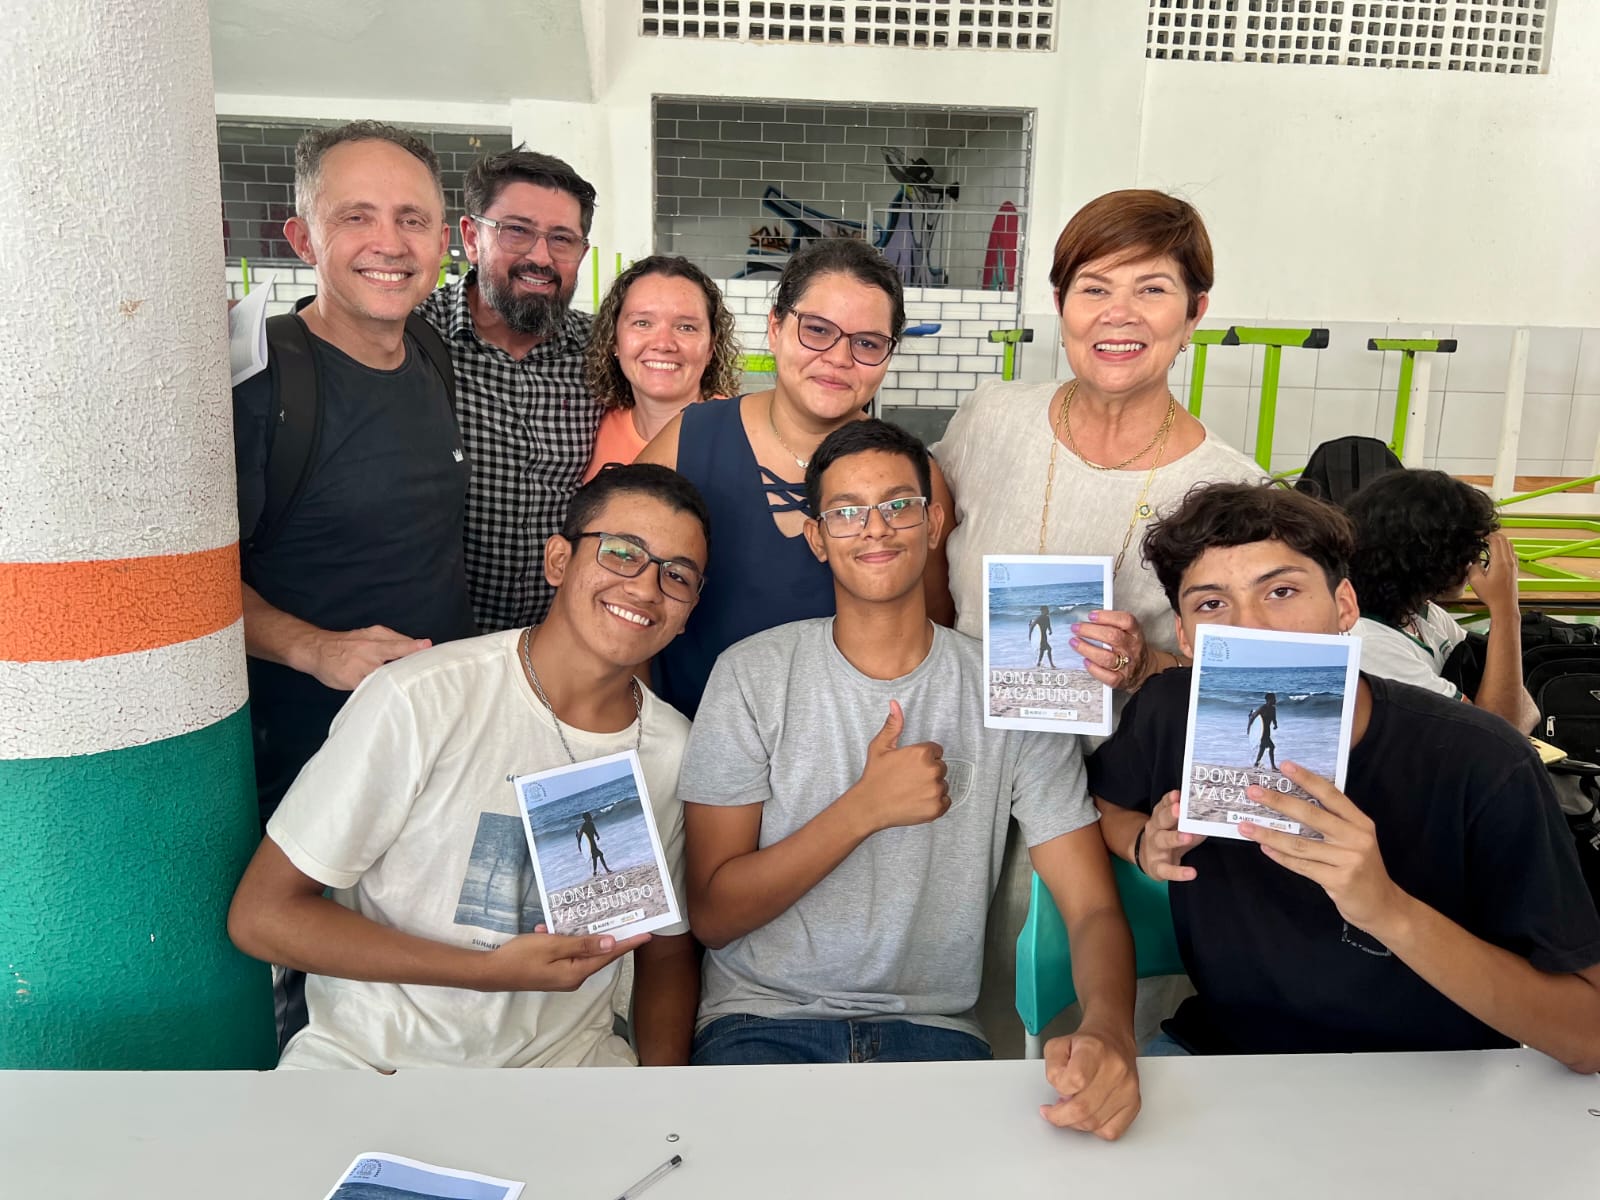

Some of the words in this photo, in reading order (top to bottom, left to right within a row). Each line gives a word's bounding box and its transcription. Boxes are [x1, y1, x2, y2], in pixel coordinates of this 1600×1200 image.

[992, 671, 1035, 685] DONA
[1041, 672, 1051, 686] E
[1056, 673, 1068, 687] O
[992, 686, 1091, 703] VAGABUNDO
[1193, 765, 1249, 787] DONA
[1258, 774, 1271, 789] E
[1276, 777, 1292, 793] O
[551, 884, 596, 908] DONA
[600, 879, 611, 894] E
[614, 875, 626, 889] O
[553, 884, 652, 923] VAGABUNDO
